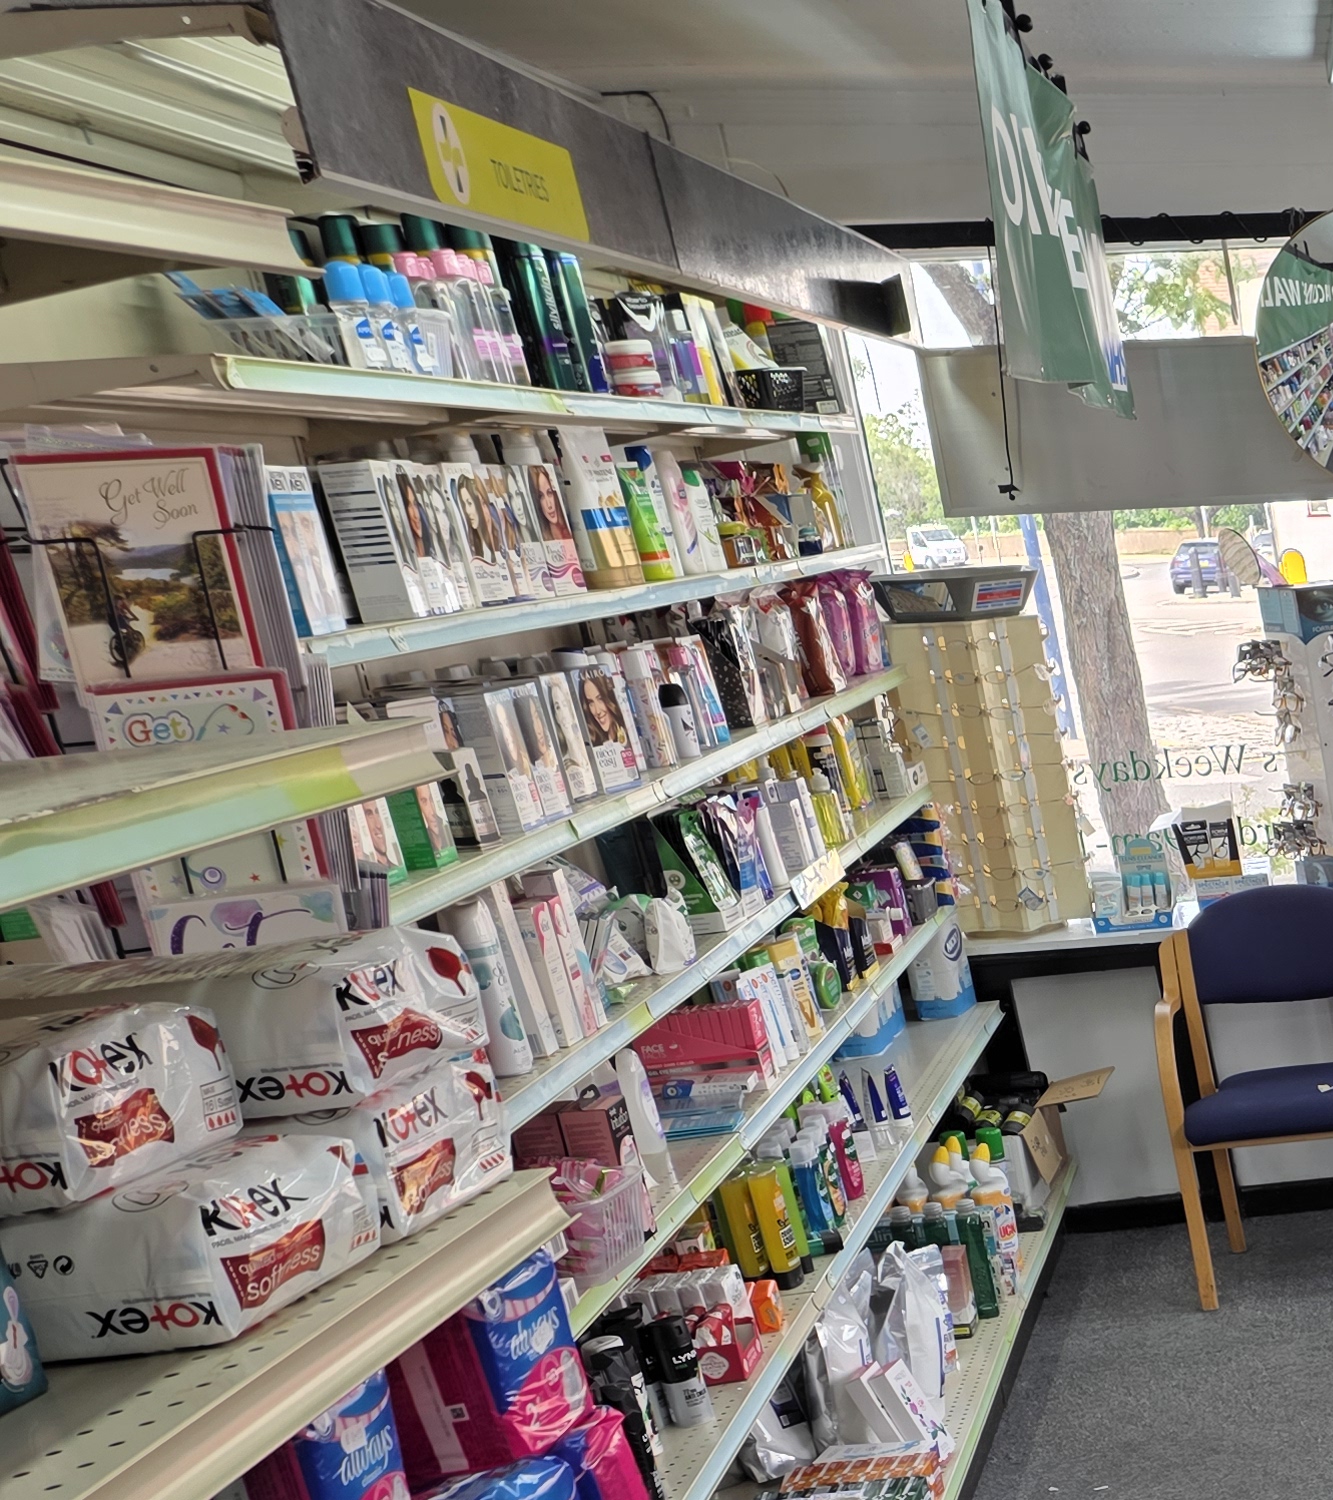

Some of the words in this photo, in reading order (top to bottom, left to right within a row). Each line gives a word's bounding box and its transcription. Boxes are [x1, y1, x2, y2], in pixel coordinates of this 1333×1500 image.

[490, 158, 549, 203] TOILETRIES
[99, 478, 142, 526] Get
[143, 467, 189, 499] Well
[152, 498, 198, 529] Soon
[123, 713, 195, 748] Get
[48, 1032, 153, 1098] Kotex
[641, 1043, 665, 1054] FACE
[236, 1070, 355, 1104] Kotex
[373, 1086, 449, 1148] Kotex
[200, 1177, 309, 1237] Kotex
[246, 1245, 322, 1301] softness
[87, 1301, 223, 1338] Kotex
